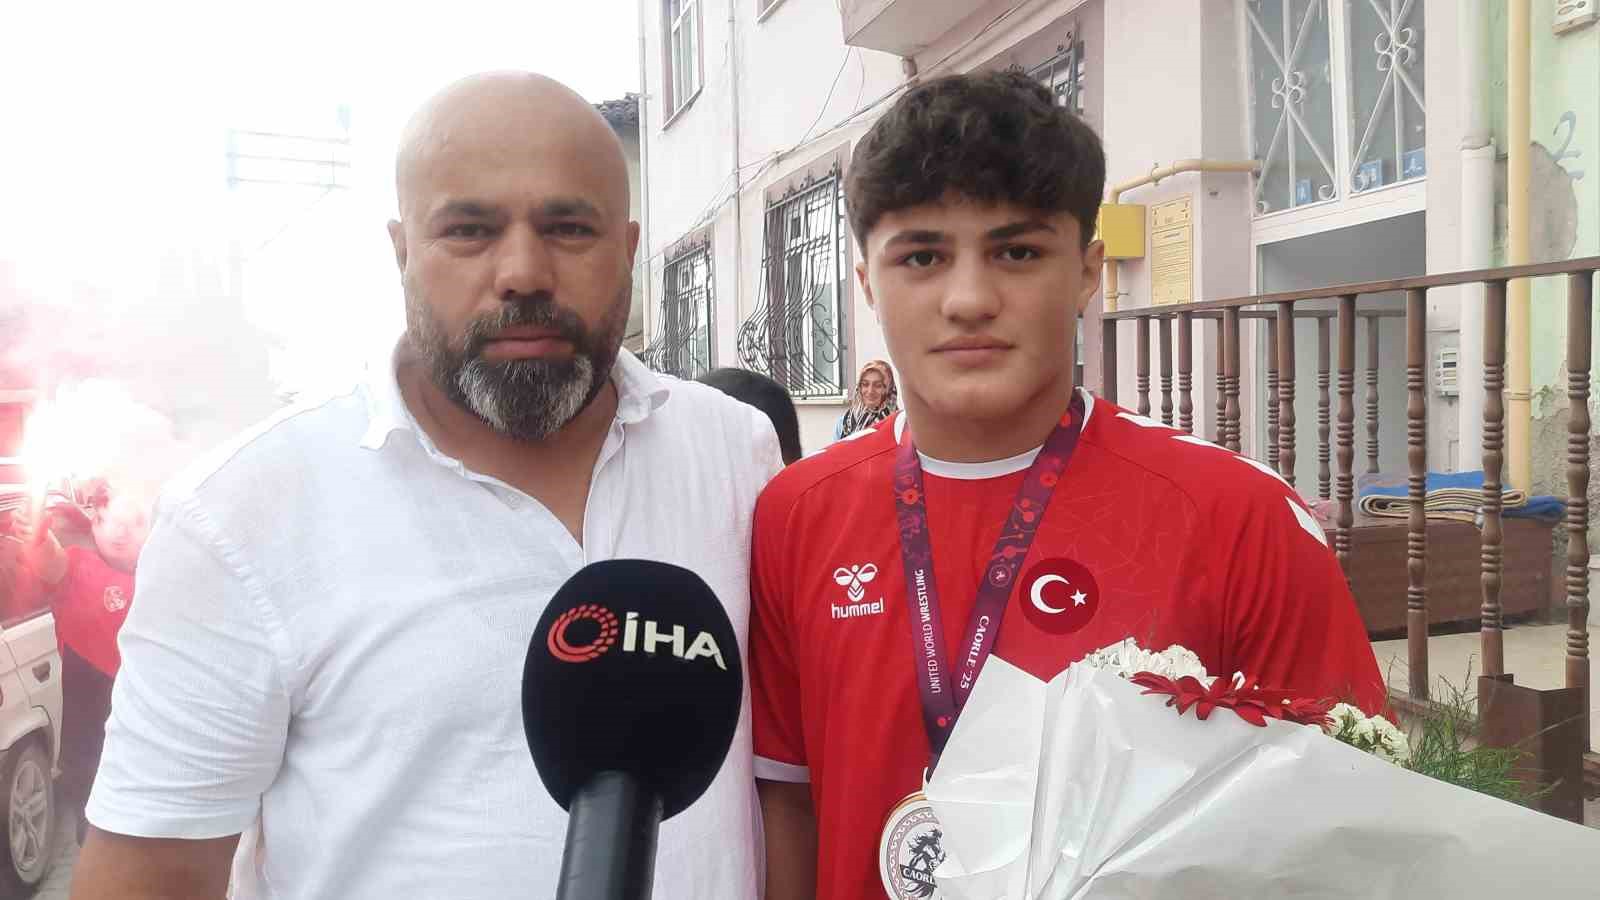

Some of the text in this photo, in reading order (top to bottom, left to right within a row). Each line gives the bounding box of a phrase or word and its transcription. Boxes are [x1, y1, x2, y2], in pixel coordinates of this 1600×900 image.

[831, 597, 884, 619] hummel
[914, 568, 941, 694] UNITED WORLD WRESTLING
[623, 612, 727, 671] İHA
[966, 615, 990, 668] CAORLE
[903, 867, 935, 884] CAORL
